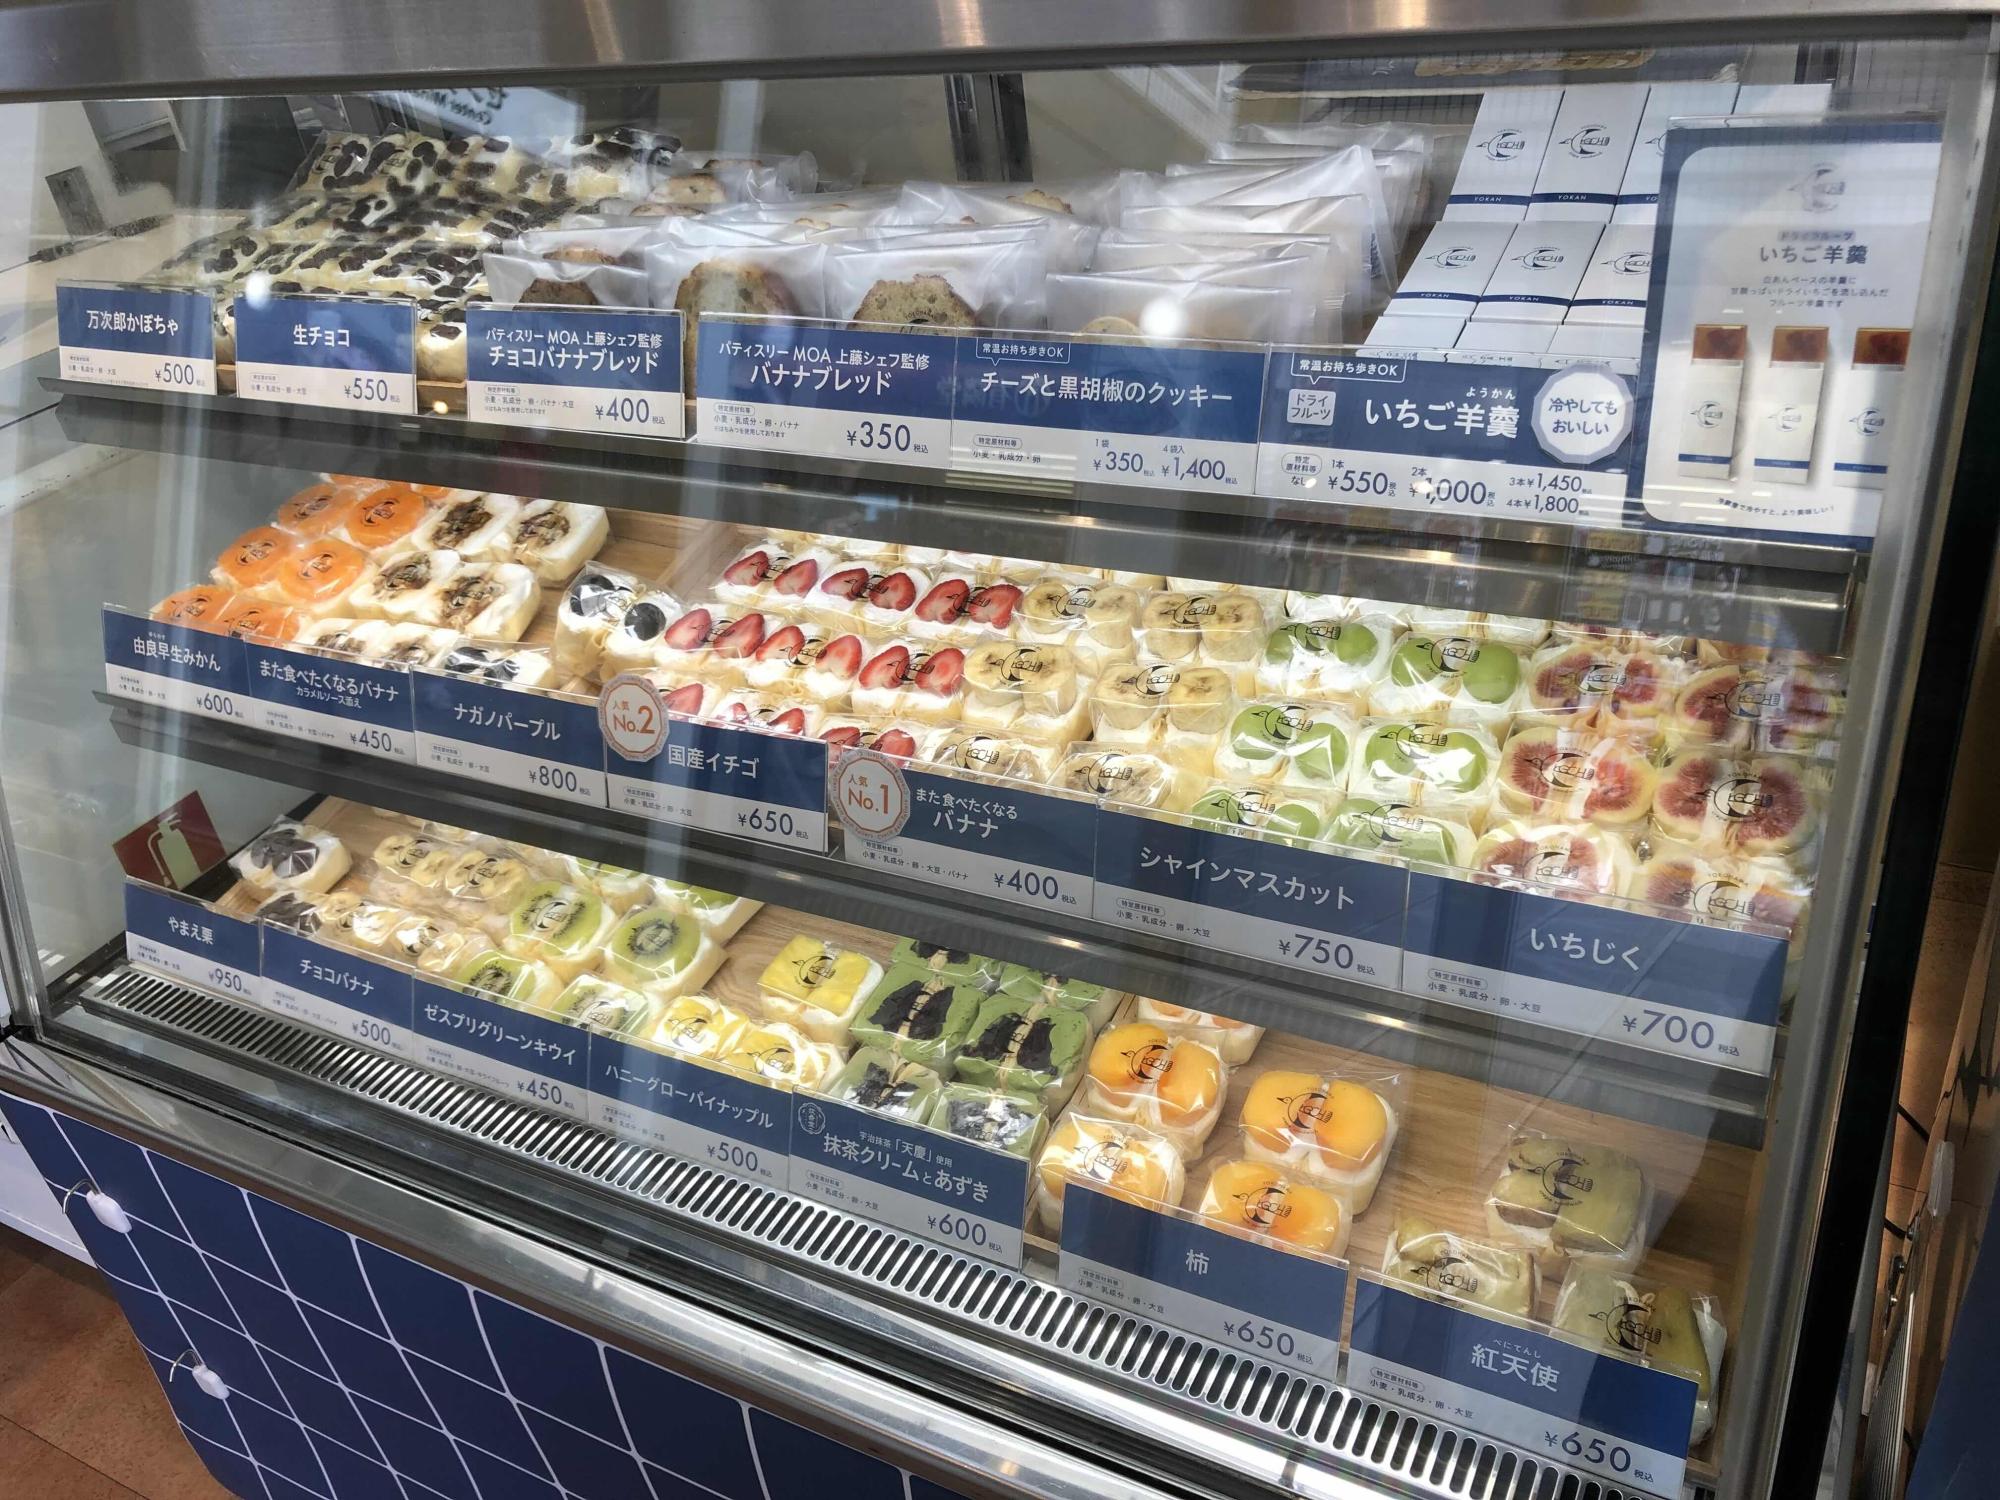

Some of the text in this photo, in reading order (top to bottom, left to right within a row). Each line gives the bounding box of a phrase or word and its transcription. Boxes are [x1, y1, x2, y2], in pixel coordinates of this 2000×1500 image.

[1557, 194, 1587, 202] YOKAN
[1759, 244, 1868, 264] いちご羊羹
[1509, 295, 1540, 303] YOKAN
[86, 310, 179, 336] 万次郎かぼちゃ
[293, 324, 350, 347] 生チョコ
[486, 328, 663, 349] パティスリー MOA 上藤シェフ監修
[982, 343, 1064, 359] 常温お持ち歩きOK
[489, 346, 659, 375] チョコバナナブレッド
[719, 341, 930, 371] パティスリー MOA 上藤シェフ監修
[1299, 359, 1398, 377] 常温お持ち歩きOK
[155, 362, 194, 385] ¥500
[750, 361, 892, 396] バナナブレッド
[344, 377, 388, 402] ¥550
[980, 371, 1233, 408] チーズと黒胡椒のクッキー
[1295, 392, 1329, 407] ドライ
[1466, 386, 1516, 400] ようかん
[595, 396, 666, 425] ¥400 税込
[717, 404, 751, 414] 特定原材料等
[1290, 405, 1331, 421] フルーツ
[1365, 398, 1520, 439] いちご羊羹
[1548, 398, 1618, 415] 冷やしても
[847, 420, 929, 454] ¥350 税込
[1552, 418, 1611, 435] おいしい
[978, 437, 1017, 447] 特定原材料等
[1093, 451, 1144, 473] ¥350
[1161, 457, 1226, 481] ¥1,400
[1286, 462, 1317, 473] 原材料等
[1295, 456, 1310, 464] 特定
[1331, 459, 1428, 477] 1本 2本
[1328, 470, 1389, 496] ¥550
[133, 637, 221, 672] 由良早生みかん
[259, 660, 399, 702] また食べたくなるバナナ
[196, 693, 233, 716] ¥600
[296, 686, 362, 709] カラメルソース添え
[613, 700, 630, 711] 人気
[454, 703, 561, 741] ナガノパープル
[613, 706, 655, 734] No.2
[350, 728, 392, 752] ¥450
[668, 744, 760, 779] 国産イチゴ
[529, 765, 577, 792] ¥800
[848, 774, 868, 788] 人気
[848, 784, 889, 815] No.1
[915, 788, 1018, 820] また食べたくなる
[738, 808, 809, 840] ¥650 税込
[933, 811, 999, 839] バナナ
[994, 869, 1077, 905] ¥400 税込
[1139, 846, 1354, 911] シャインマスカット
[168, 916, 214, 945] やまえ栗
[1116, 910, 1210, 938] 小麦・乳成分・卵・大豆
[1279, 933, 1375, 976] ¥750 税込
[1530, 927, 1641, 972] いちじく
[208, 968, 242, 992] ¥950
[299, 959, 374, 996] チョコバナナ
[1434, 971, 1481, 987] 特定原材料等
[1428, 981, 1542, 1014] 小麦・乳成分・卵・大豆
[352, 1019, 391, 1045] ¥500
[424, 1004, 576, 1065] ゼスプリグリーンキウイ
[1623, 1008, 1740, 1057] ¥700 税込
[517, 1080, 562, 1105] ¥450
[605, 1064, 774, 1129] ハニーグローパイナップル
[707, 1141, 758, 1172] ¥500
[823, 1132, 989, 1204] 抹茶クリームとあずき
[936, 1155, 953, 1168] 使用
[927, 1214, 1003, 1254] ¥600 税込
[1185, 1249, 1210, 1275] 柿
[1223, 1320, 1314, 1366] ¥650 税込
[1493, 1338, 1542, 1360] べにてんし
[1376, 1371, 1419, 1389] 特定原材料等
[1471, 1343, 1560, 1393] 紅天使
[1369, 1378, 1474, 1419] 小麦・乳成分・卵・大豆
[1545, 1432, 1654, 1484] ¥650 税込
